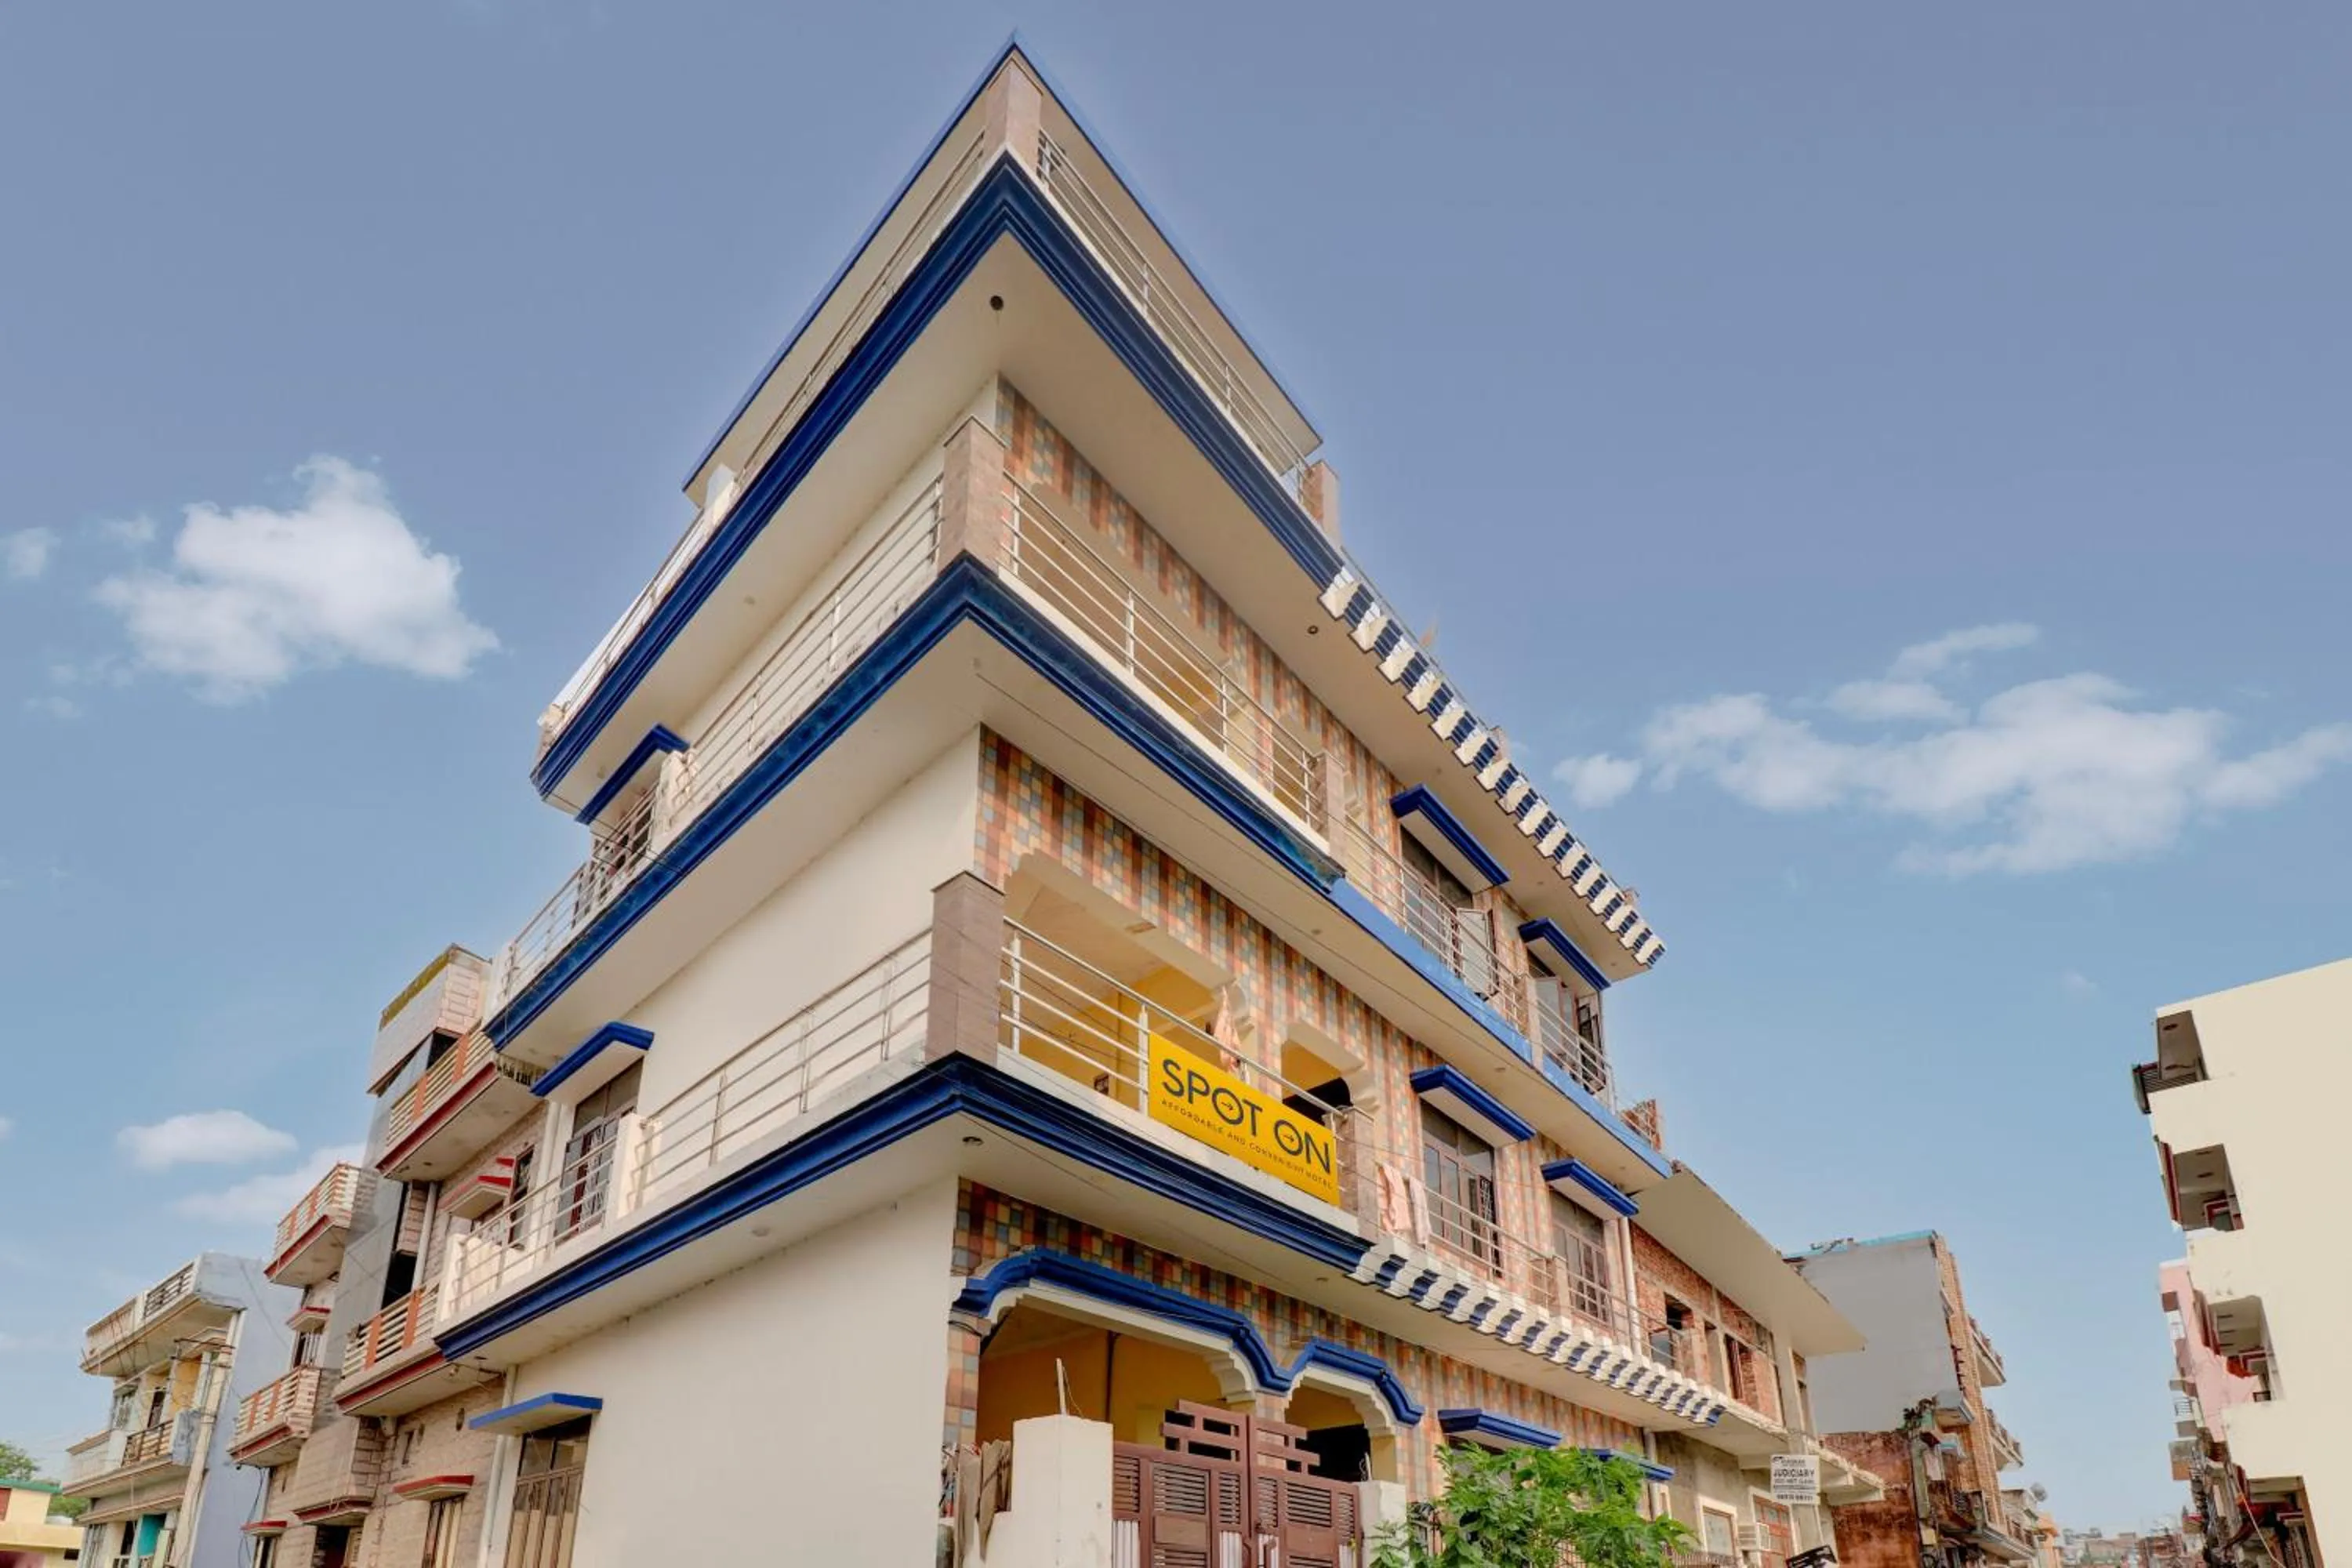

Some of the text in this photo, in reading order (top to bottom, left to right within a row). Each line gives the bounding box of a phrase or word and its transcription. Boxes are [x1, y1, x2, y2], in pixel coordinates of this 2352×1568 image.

[1161, 1098, 1224, 1134] AFFORDABLE
[1227, 1131, 1246, 1145] AND
[1162, 1059, 1330, 1174] SPOT ON
[1774, 1468, 1815, 1478] JUDICIARY
